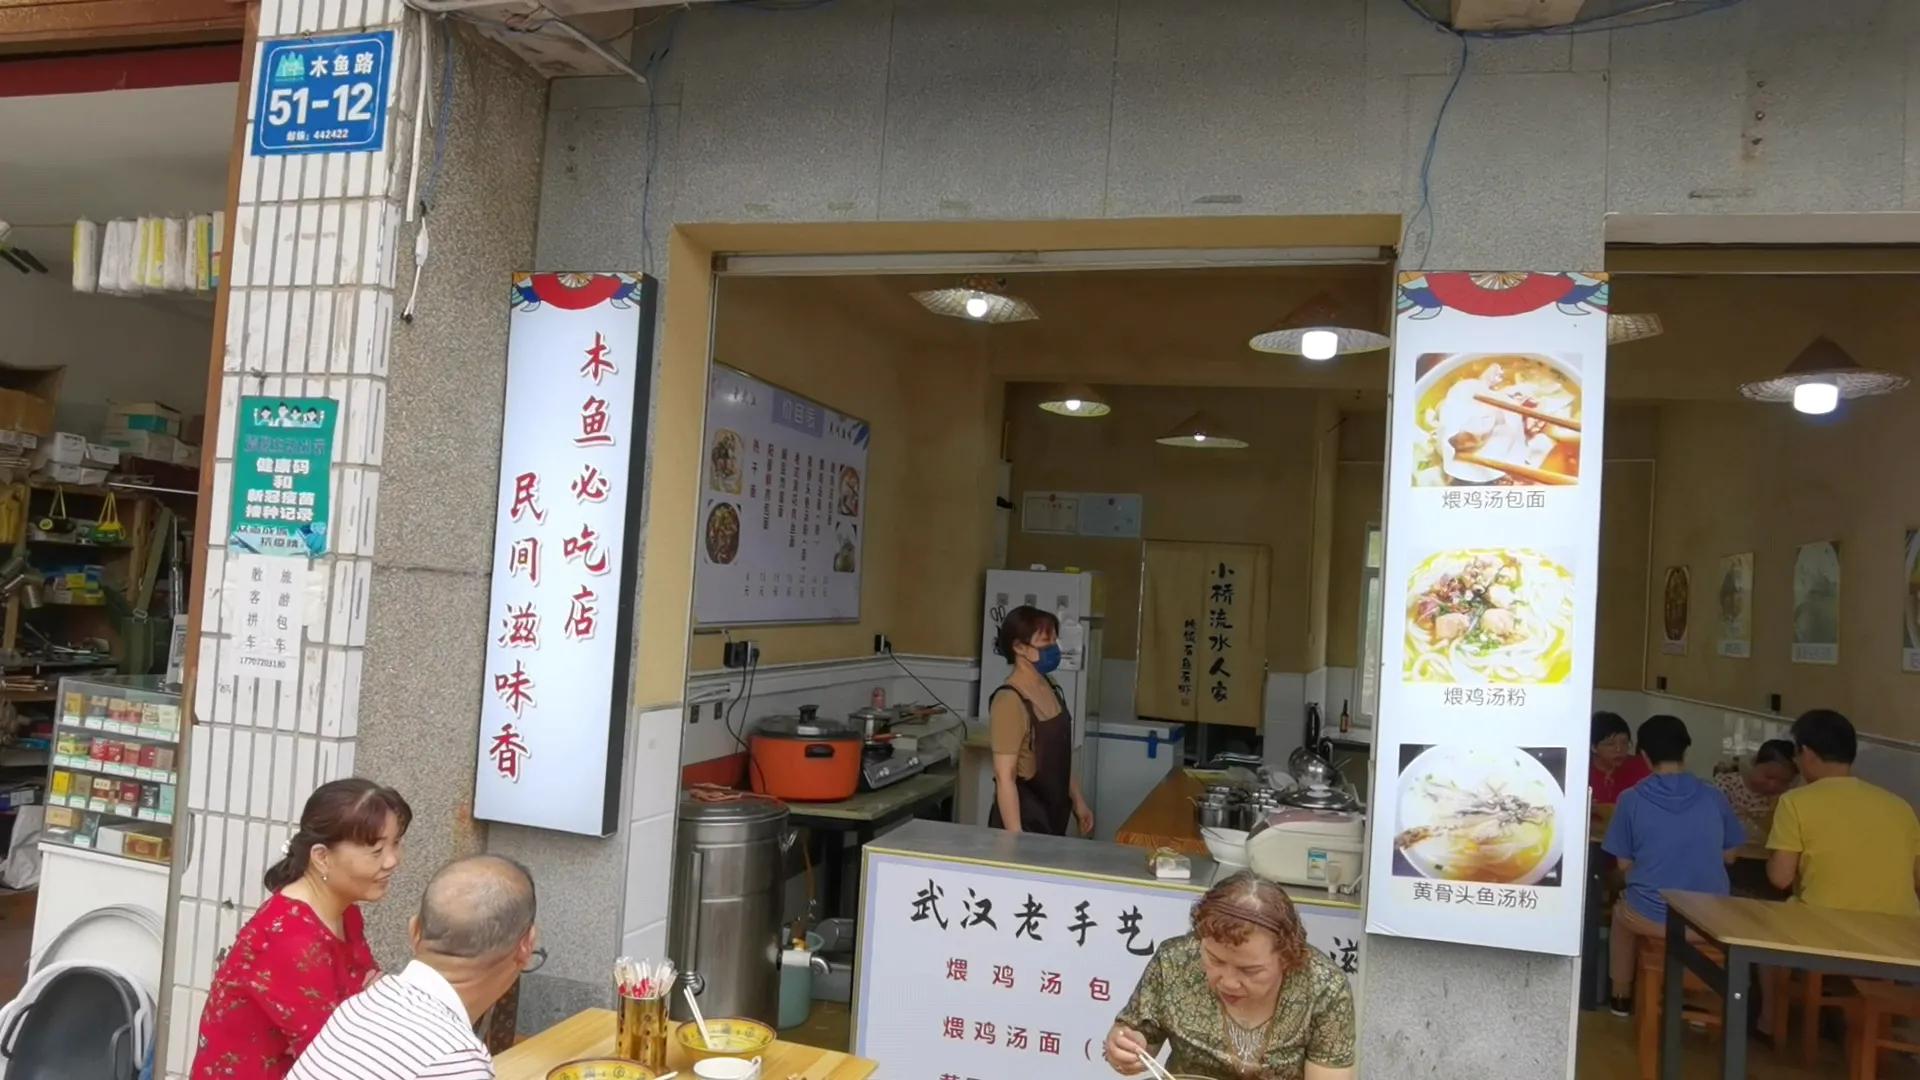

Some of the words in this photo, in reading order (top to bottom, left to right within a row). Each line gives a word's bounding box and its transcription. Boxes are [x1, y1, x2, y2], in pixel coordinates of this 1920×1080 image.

[309, 52, 374, 77] 木鱼路
[268, 82, 374, 125] 51-12
[256, 457, 310, 475] 健康码
[273, 475, 293, 489] 和
[563, 331, 616, 637] 木鱼必吃店
[247, 489, 315, 506] 新冠疫苗
[1442, 490, 1546, 510] 煨鸡汤包面
[245, 504, 314, 522] 接种记录
[491, 472, 543, 778] 民间滋味香
[1443, 687, 1527, 707] 煨鸡汤粉
[1412, 882, 1539, 910] 黄骨头鱼汤粉
[910, 878, 1155, 957] 武汉老手艺
[946, 957, 1111, 1002] 煨鸡汤包
[943, 1016, 1106, 1061] 煨鸡汤面（
